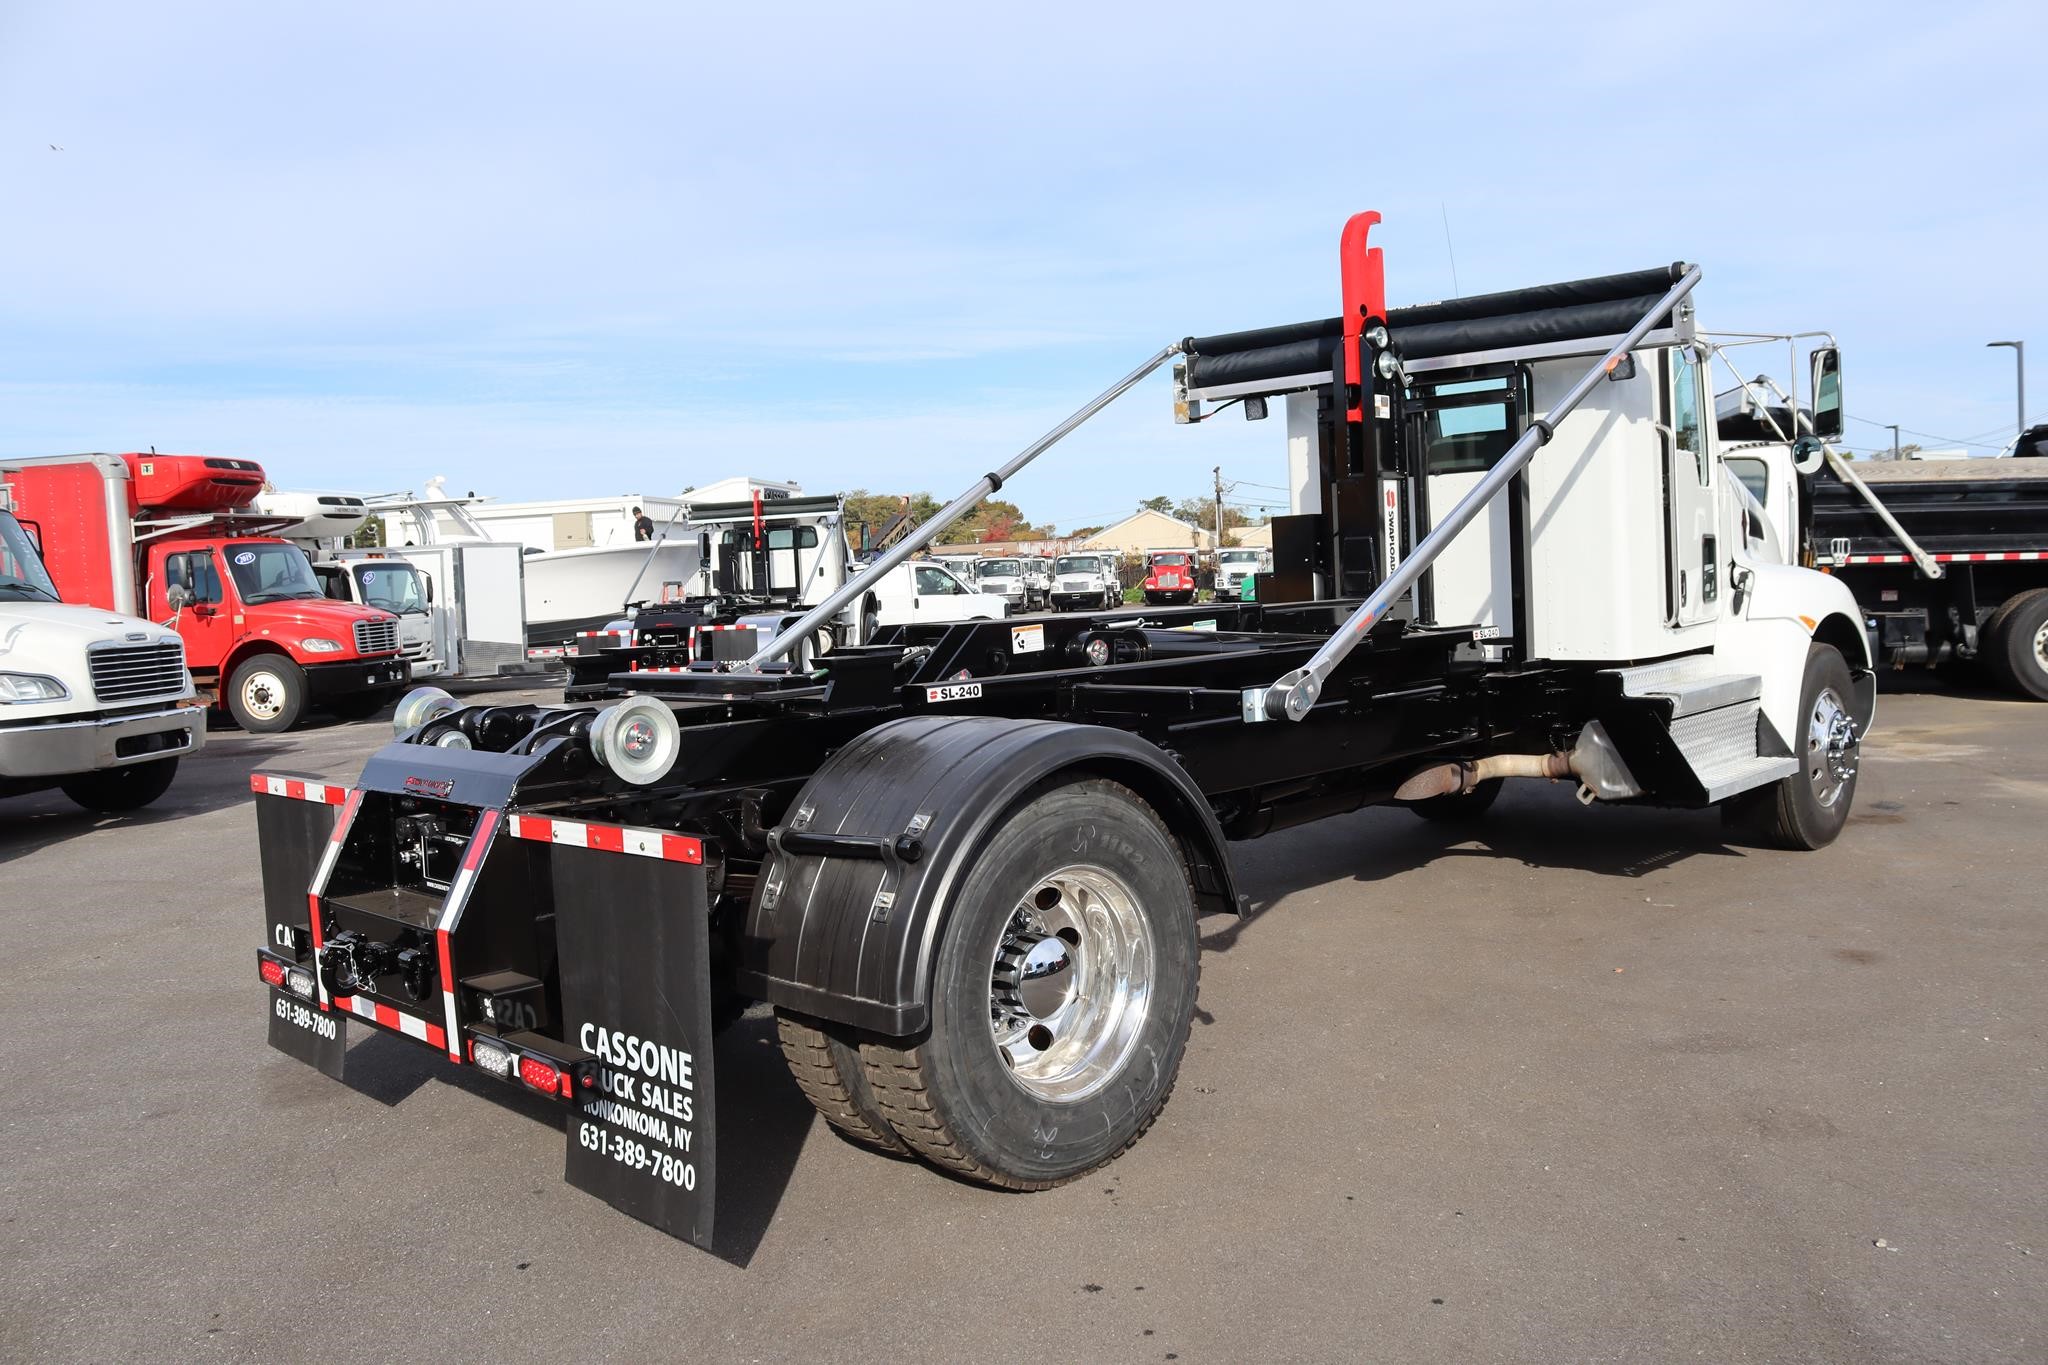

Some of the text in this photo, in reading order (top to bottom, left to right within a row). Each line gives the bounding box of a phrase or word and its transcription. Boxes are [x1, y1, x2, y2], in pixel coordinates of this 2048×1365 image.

[1388, 511, 1396, 574] SWAPLOAD
[940, 685, 980, 700] SL-240
[275, 998, 337, 1041] 631-389-7800
[580, 1022, 693, 1090] CASSONE
[602, 1068, 694, 1122] UCK SALES
[579, 1122, 696, 1192] 631-389-7800
[674, 1125, 693, 1153] NY
